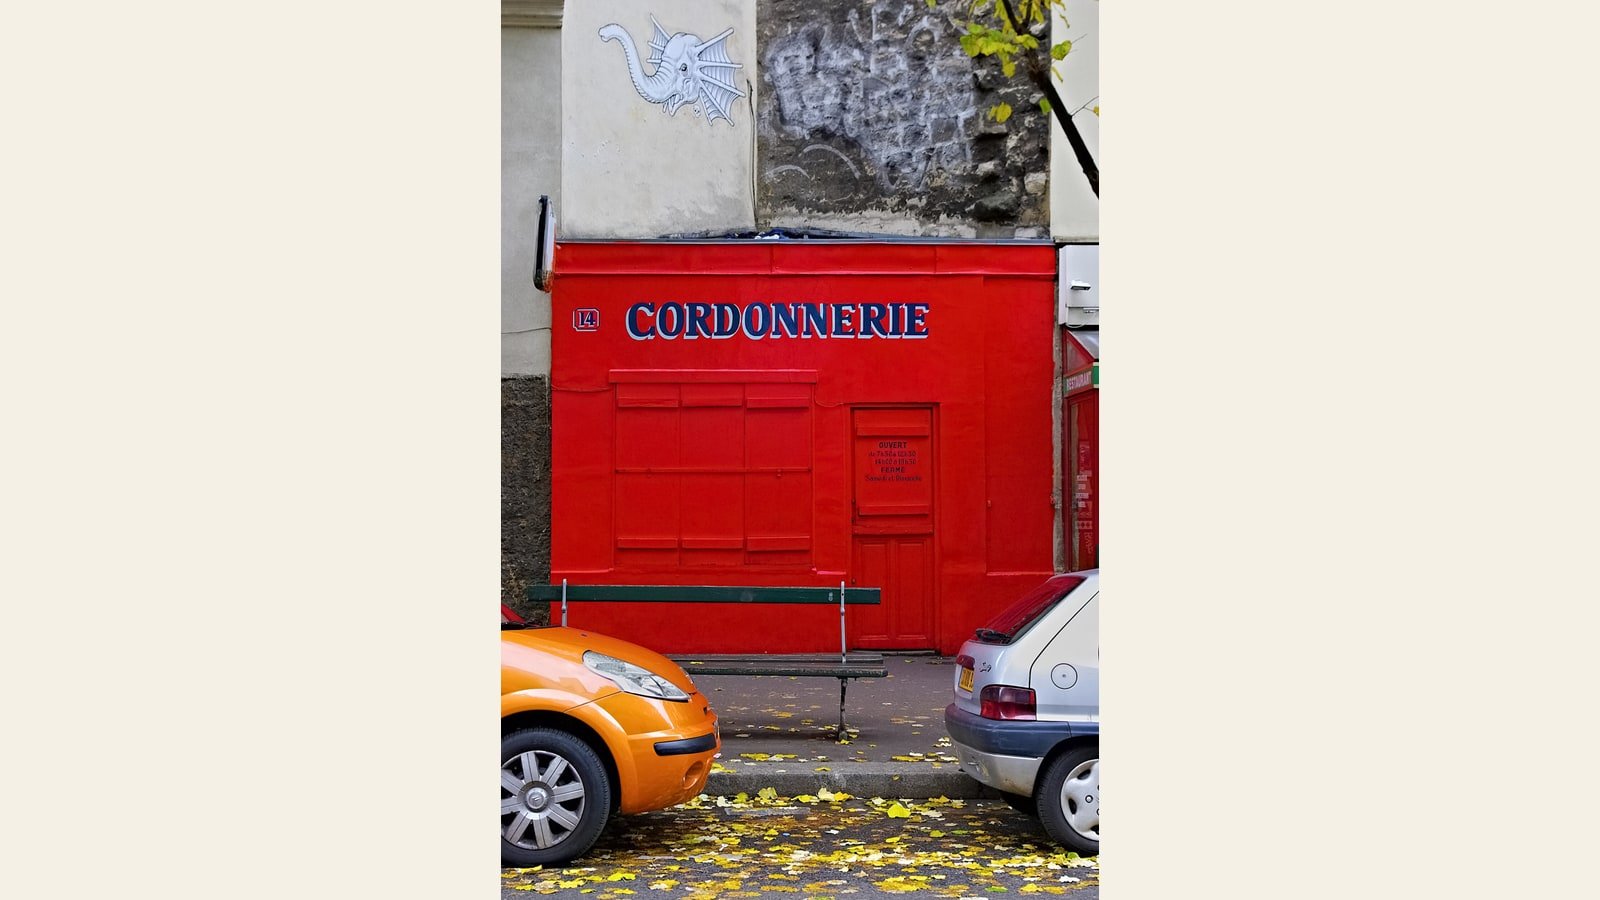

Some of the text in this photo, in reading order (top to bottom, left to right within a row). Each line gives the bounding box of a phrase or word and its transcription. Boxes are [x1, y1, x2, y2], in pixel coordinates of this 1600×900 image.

[578, 311, 597, 328] 14
[625, 302, 931, 341] CORDONNERIE
[1066, 371, 1092, 391] RESTAURANT
[878, 441, 908, 449] OUVERT
